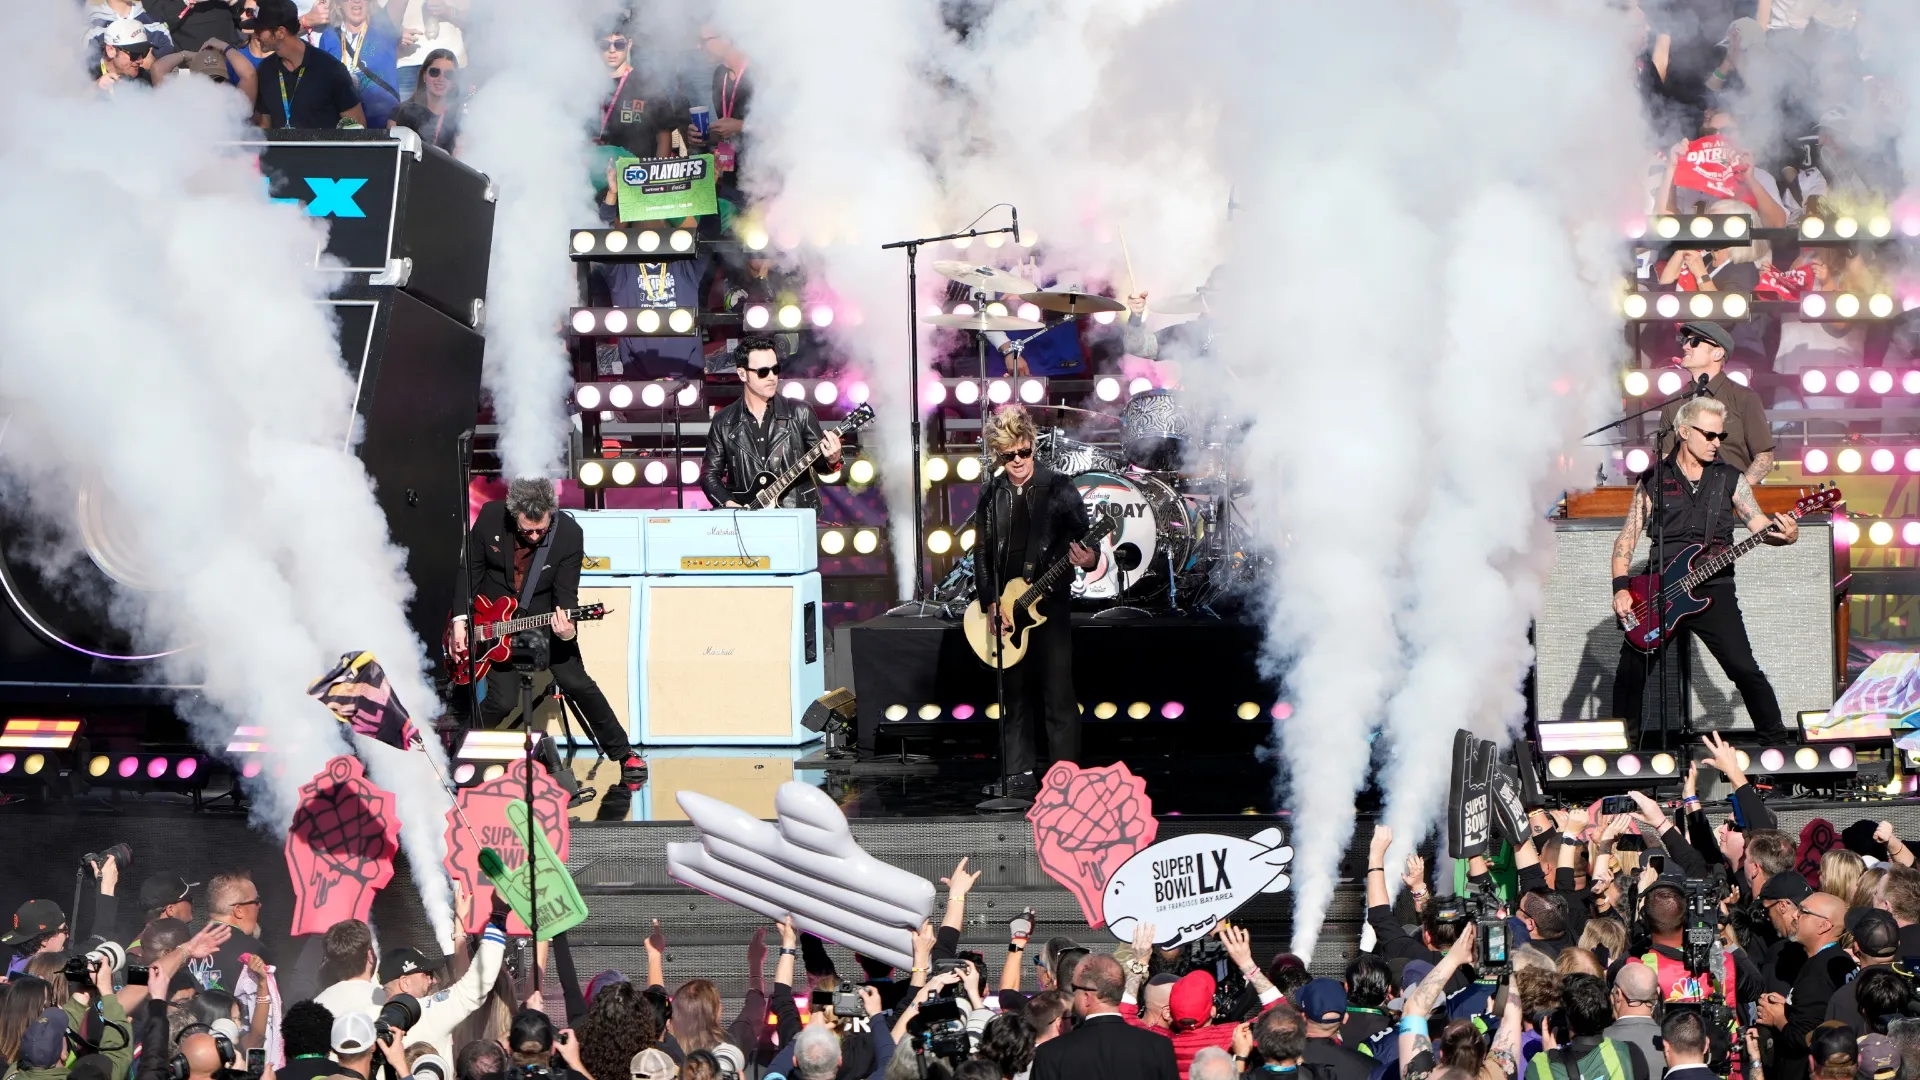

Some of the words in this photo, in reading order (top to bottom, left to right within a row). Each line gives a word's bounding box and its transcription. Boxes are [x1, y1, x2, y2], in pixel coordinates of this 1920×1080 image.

[626, 170, 647, 180] 50
[649, 160, 703, 180] PLAYOFFS
[1110, 503, 1148, 518] DAY
[1464, 794, 1488, 818] SUPER
[481, 825, 523, 846] SUPE
[1152, 855, 1194, 881] SUPER
[1196, 847, 1232, 895] LX
[1154, 875, 1197, 904] BOWL
[547, 895, 572, 918] LX
[1156, 905, 1167, 913] SAN
[1168, 899, 1198, 910] FRANCISCO
[1199, 895, 1214, 905] BAY
[1214, 892, 1234, 902] AREA
